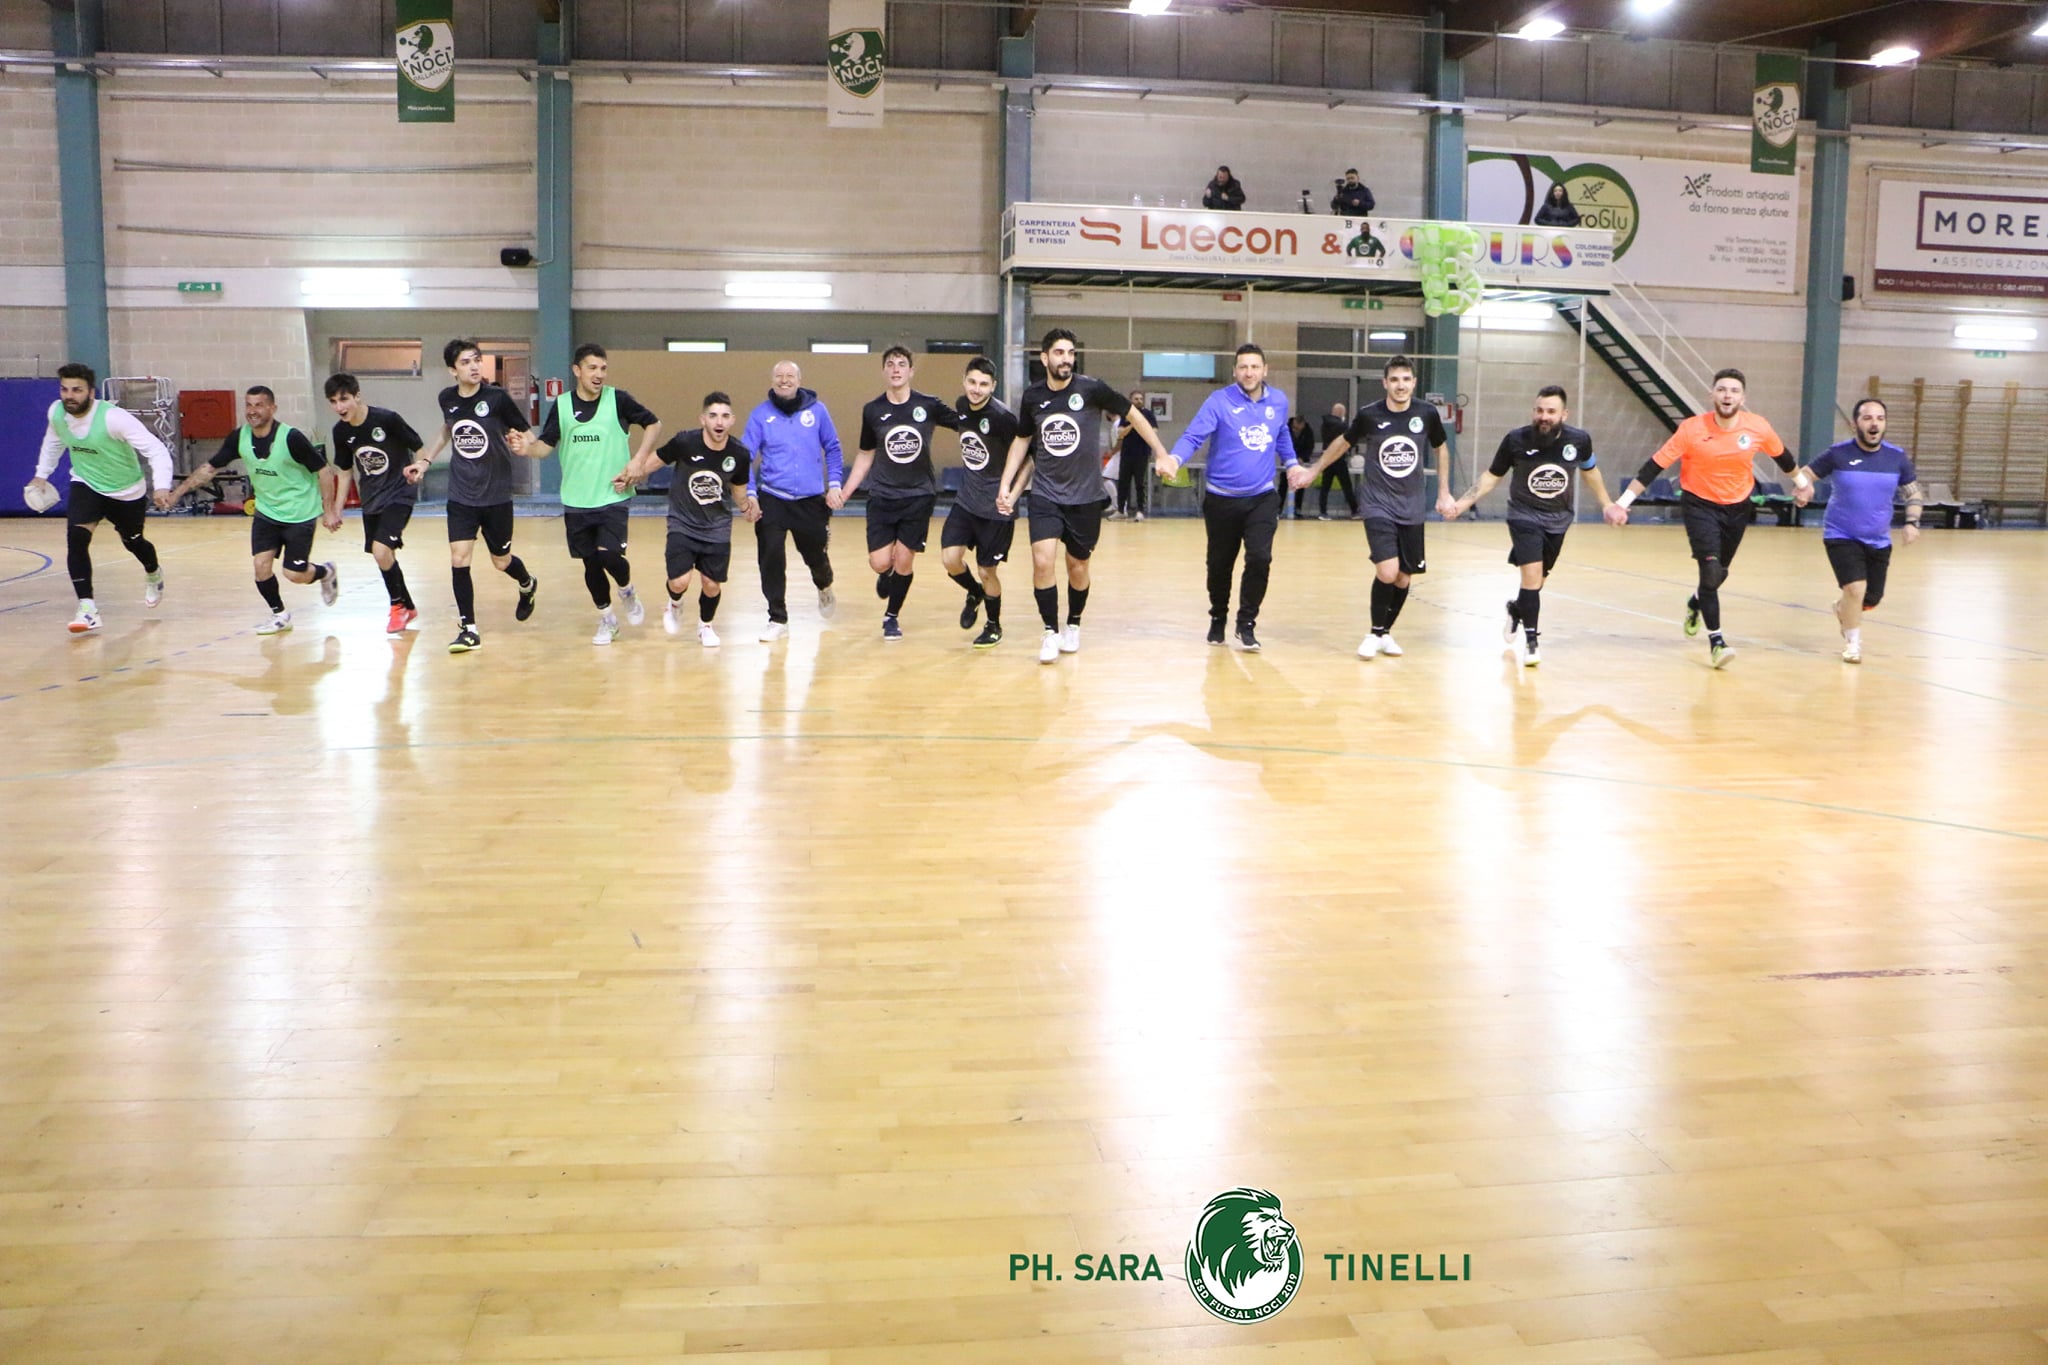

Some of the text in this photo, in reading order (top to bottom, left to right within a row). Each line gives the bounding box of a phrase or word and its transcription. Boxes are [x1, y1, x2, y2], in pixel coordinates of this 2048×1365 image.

[410, 52, 451, 75] NOCI
[840, 59, 881, 82] NOCI
[1763, 112, 1795, 131] NOCI
[1706, 186, 1744, 198] Prodotti
[1019, 219, 1076, 228] CARPENTERIA
[1025, 228, 1070, 236] METALLICA
[1934, 210, 2048, 237] MORE
[1141, 215, 1297, 256] Laecon
